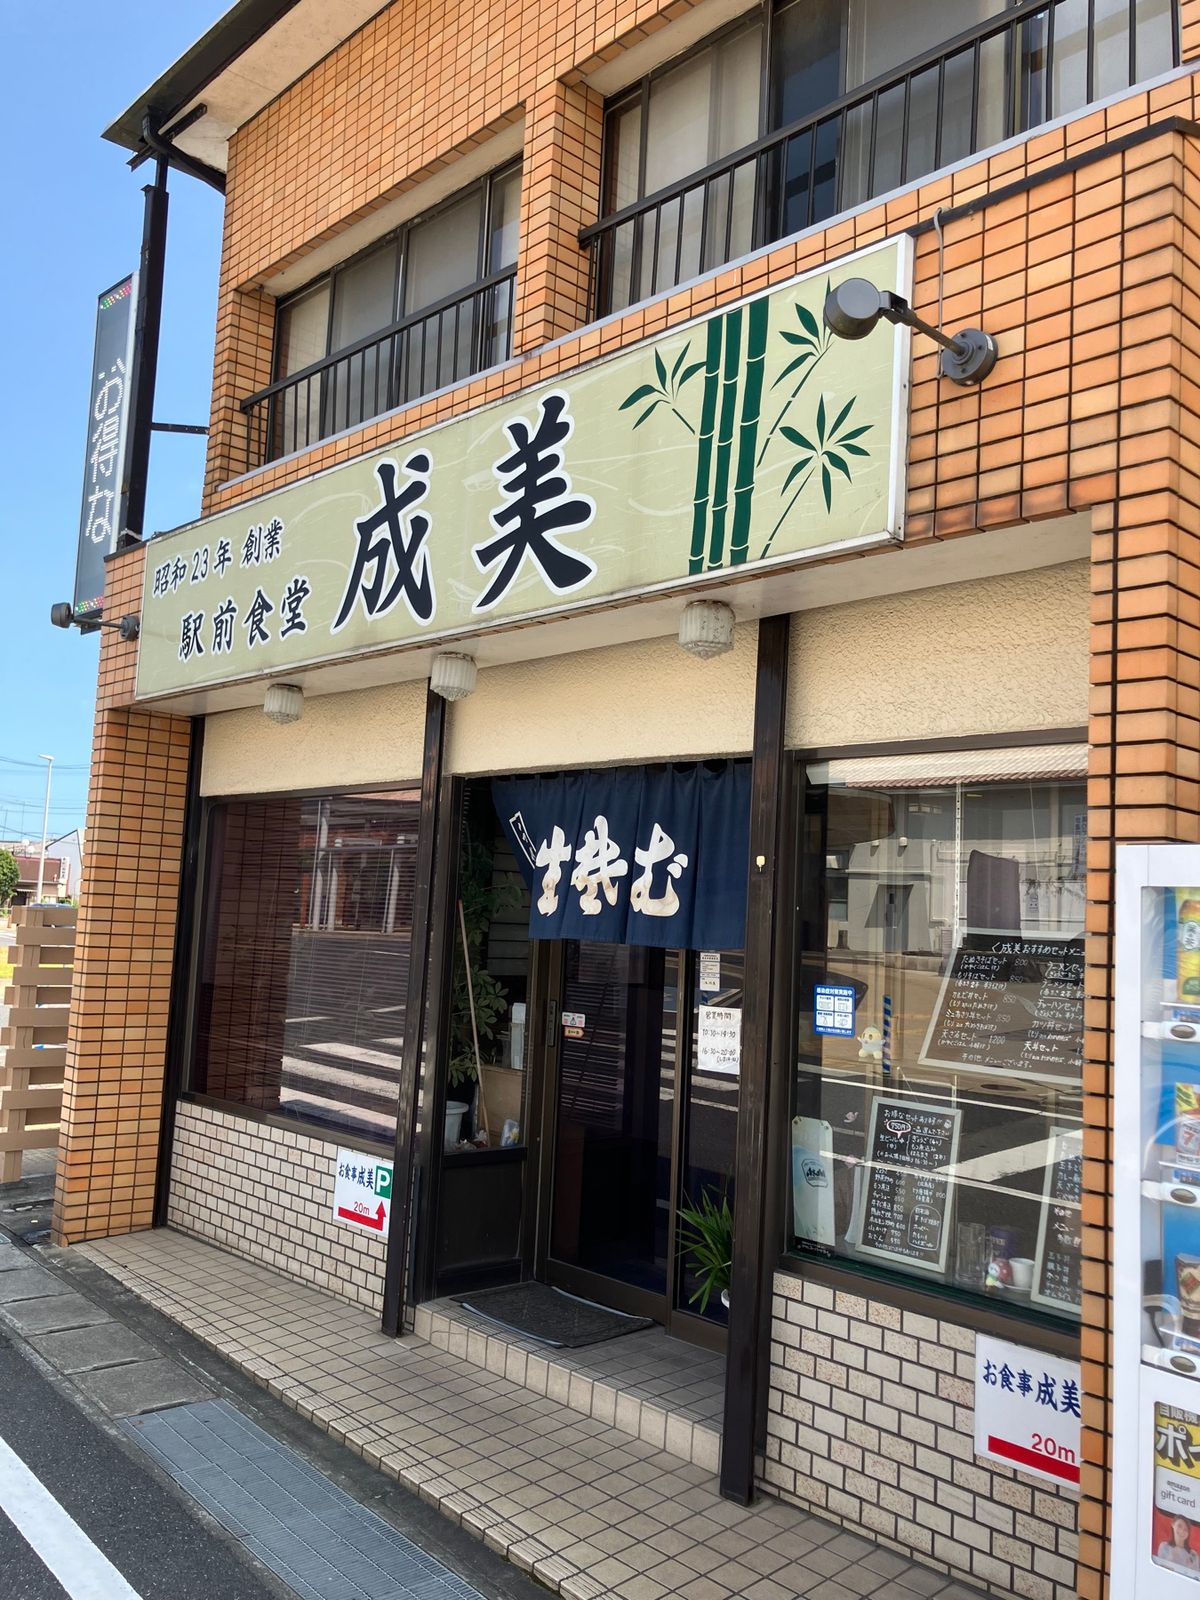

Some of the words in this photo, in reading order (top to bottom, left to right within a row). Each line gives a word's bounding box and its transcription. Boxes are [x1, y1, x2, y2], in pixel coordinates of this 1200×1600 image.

[331, 393, 593, 629] 成美
[177, 576, 311, 660] 駅前食堂
[338, 1163, 374, 1189] お食事成美
[353, 1201, 370, 1215] 20m
[982, 1359, 1081, 1418] お食事成美
[1031, 1433, 1075, 1463] 20m
[1160, 1490, 1175, 1501] gift
[1176, 1496, 1196, 1508] card
